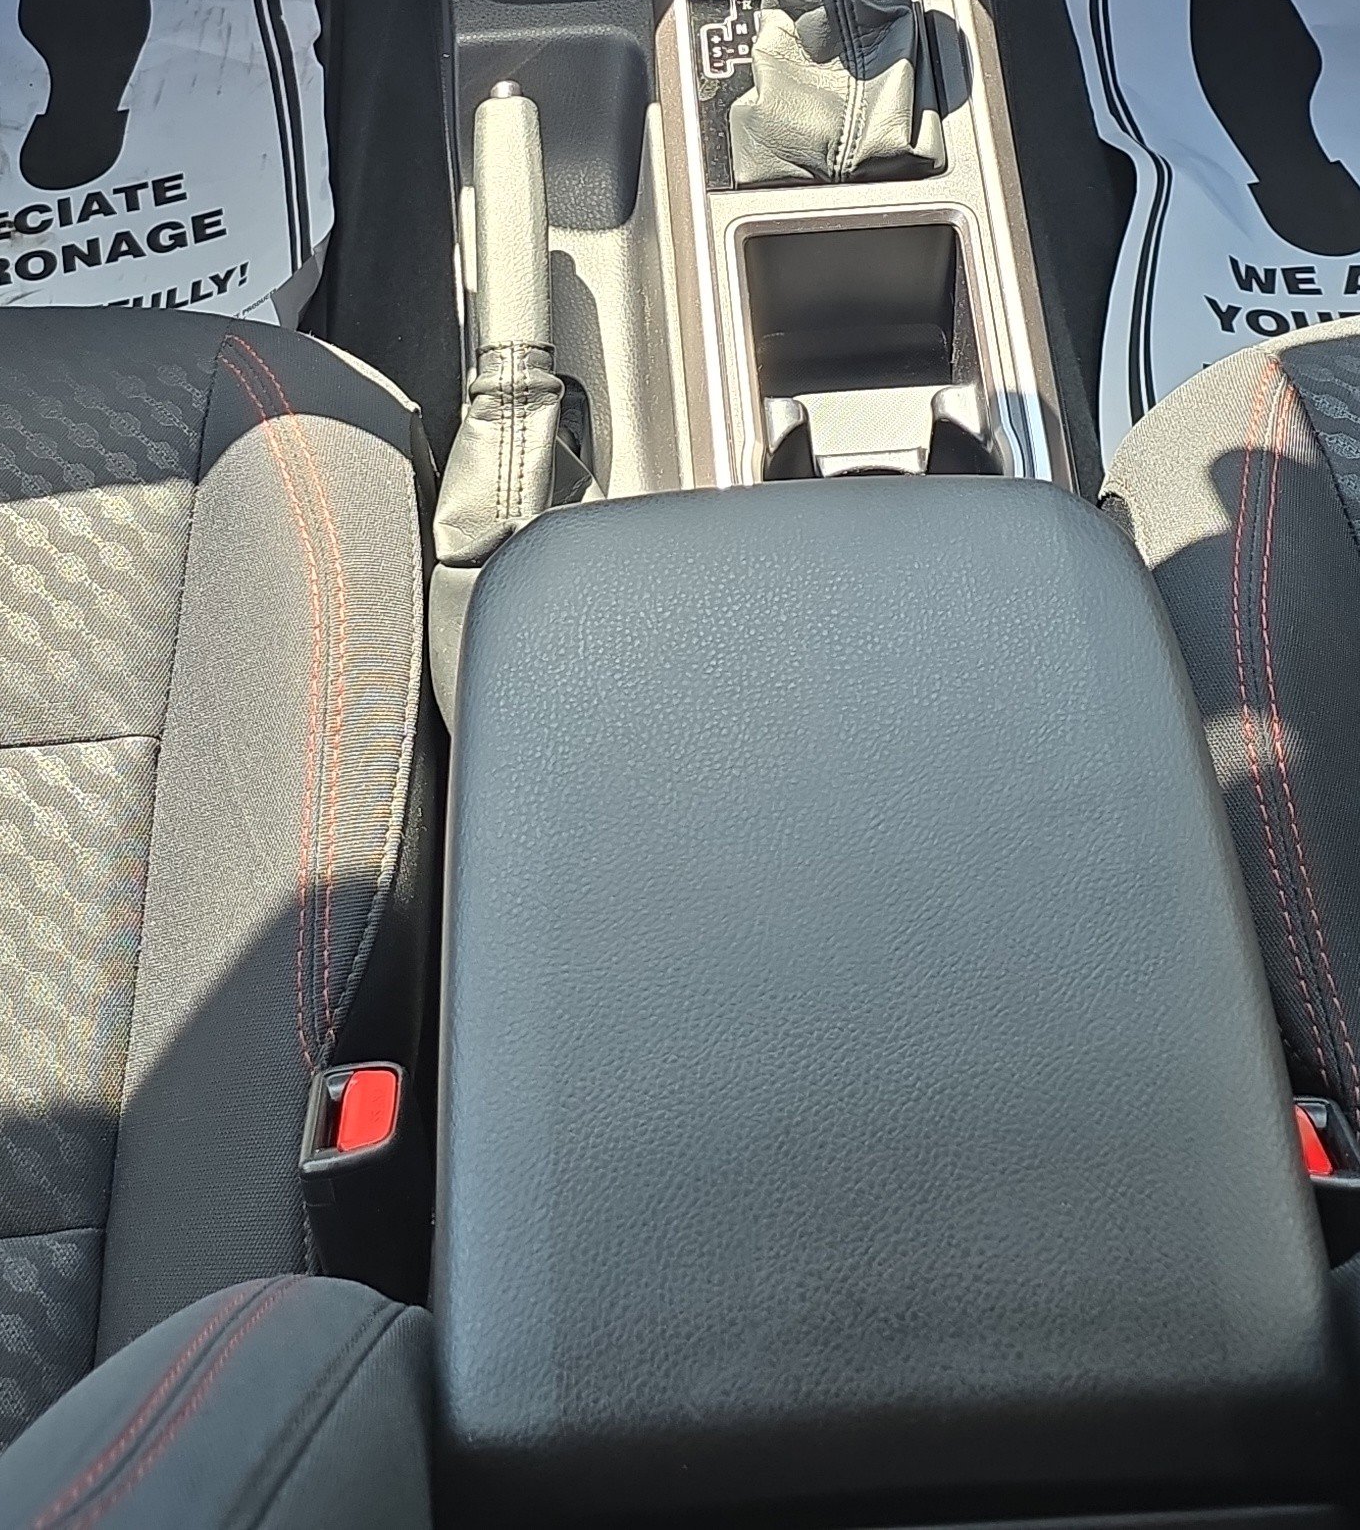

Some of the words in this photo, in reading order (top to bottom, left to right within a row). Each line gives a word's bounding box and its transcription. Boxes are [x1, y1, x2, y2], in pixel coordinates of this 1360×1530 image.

[742, 0, 752, 10] R
[735, 23, 748, 34] N
[712, 46, 722, 57] S
[737, 44, 750, 55] D
[1228, 255, 1323, 295] WE
